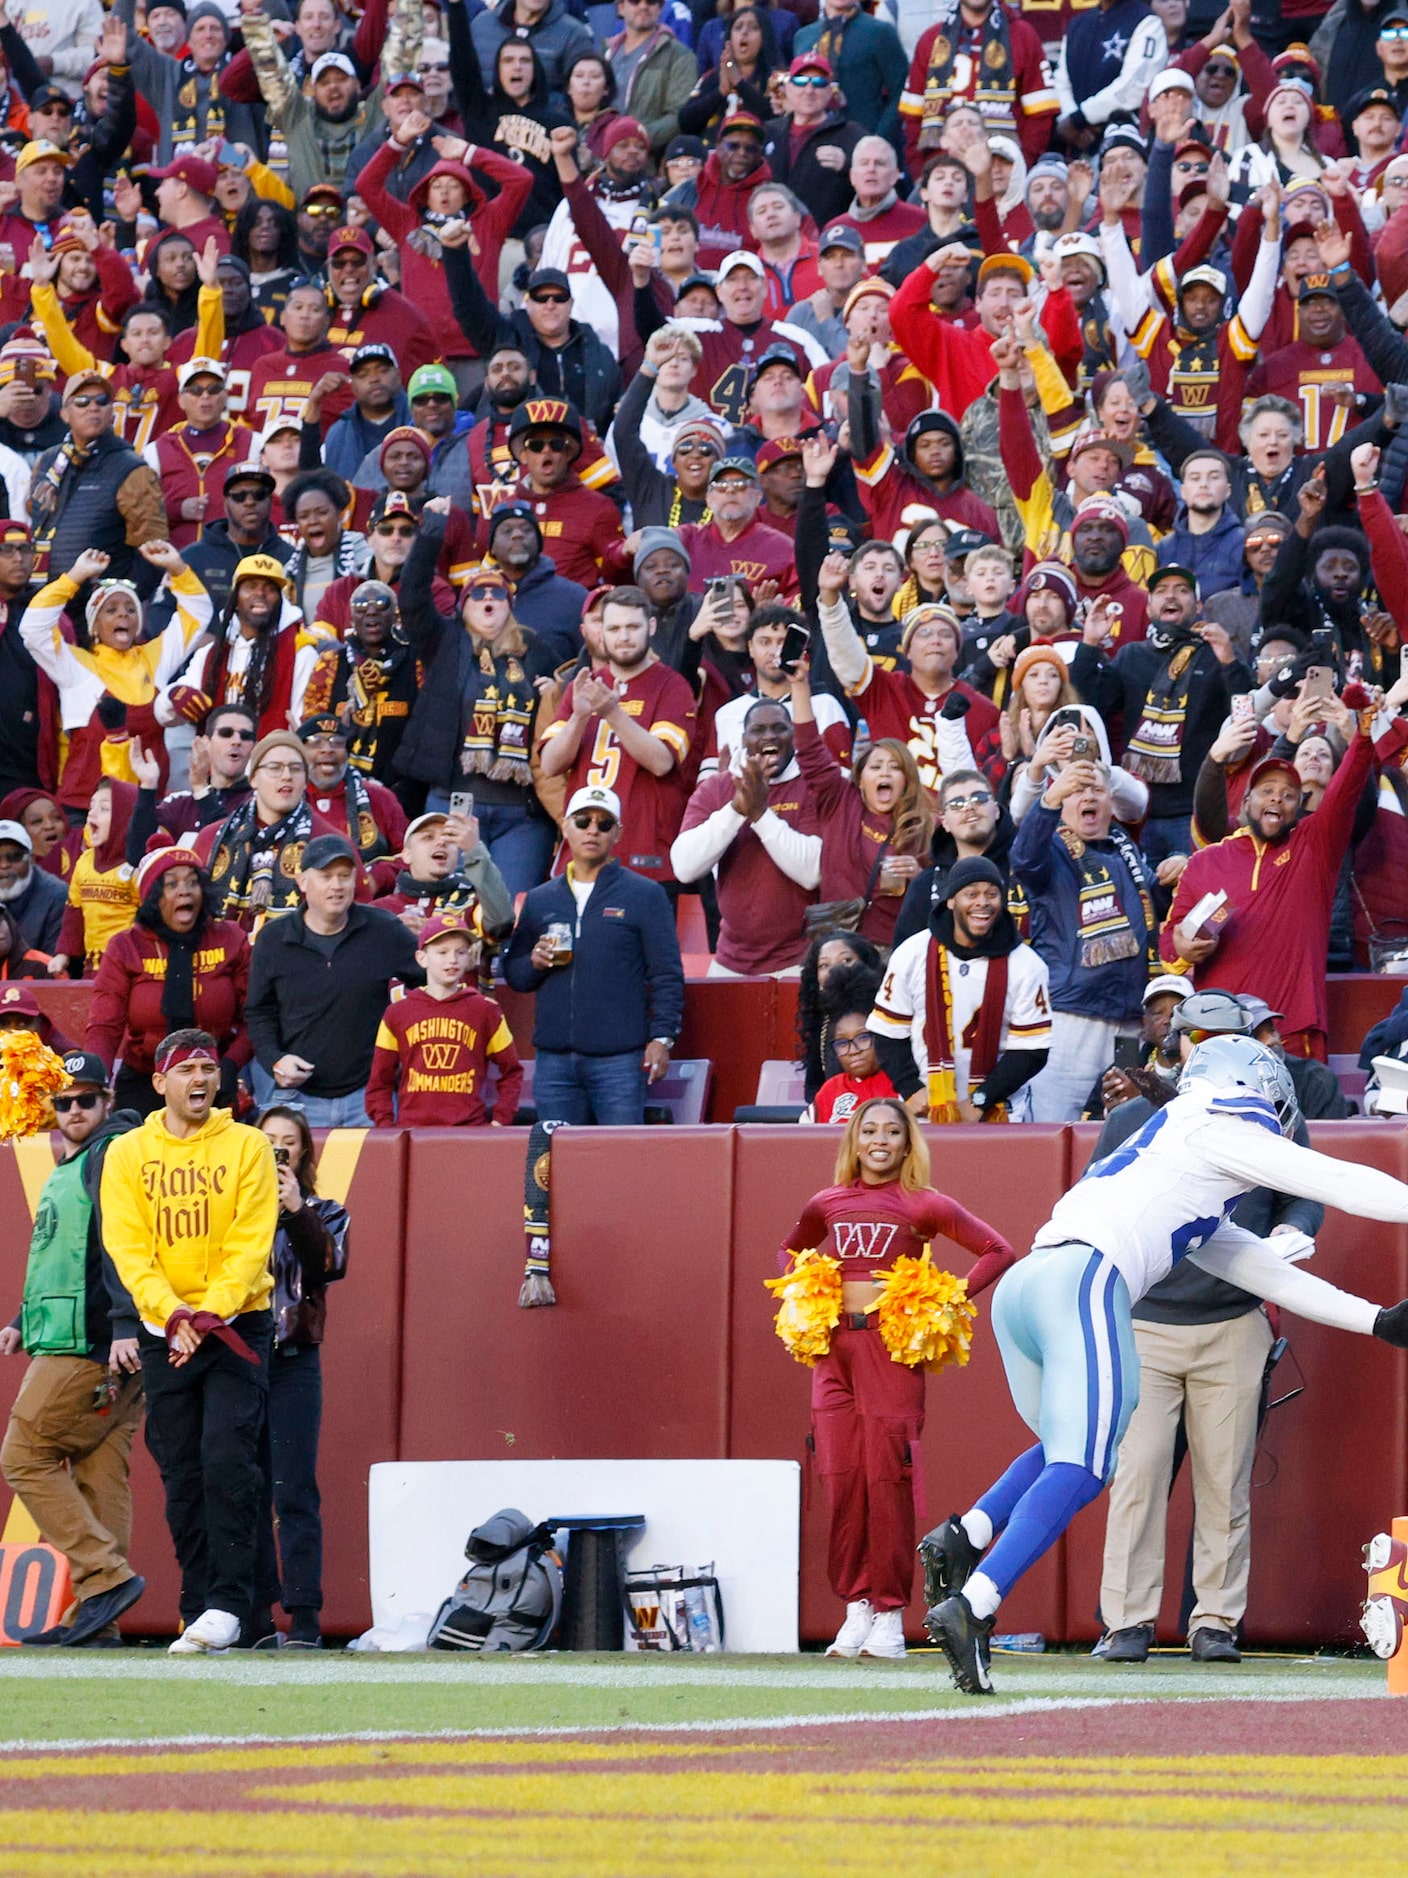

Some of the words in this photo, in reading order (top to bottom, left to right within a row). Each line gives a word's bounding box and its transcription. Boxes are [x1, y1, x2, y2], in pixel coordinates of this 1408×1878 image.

[525, 400, 568, 424] W
[710, 363, 748, 427] 4
[587, 719, 620, 788] 5
[407, 1017, 477, 1051] WASHINGTON
[65, 1057, 85, 1073] W
[422, 1044, 461, 1069] W
[142, 1160, 227, 1200] Raise
[834, 1222, 897, 1258] W
[0, 1547, 56, 1641] 0
